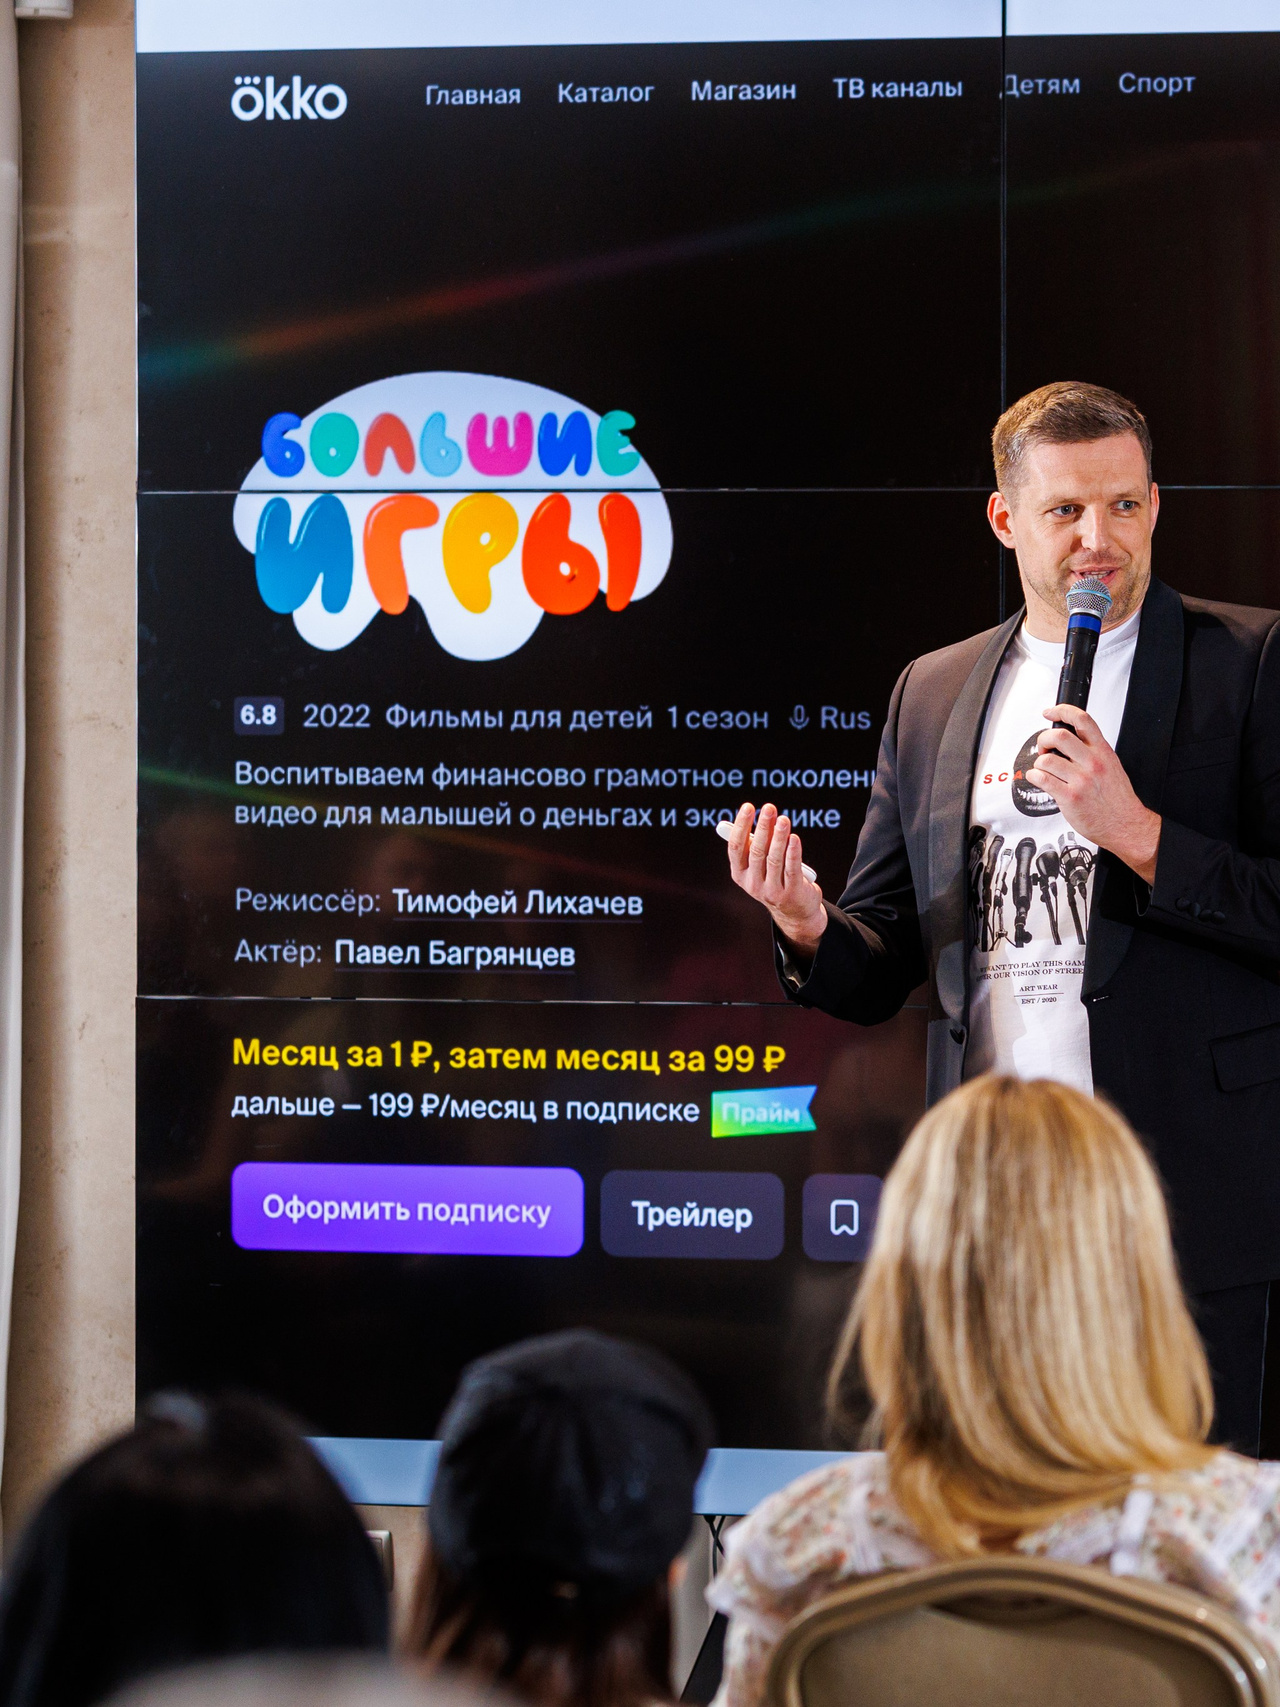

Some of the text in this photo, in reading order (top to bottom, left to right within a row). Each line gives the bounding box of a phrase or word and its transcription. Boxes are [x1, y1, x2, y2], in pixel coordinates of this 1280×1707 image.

[425, 85, 522, 105] Главная
[557, 82, 654, 104] Каталог
[691, 80, 797, 102] Магазин
[833, 78, 963, 99] ТВ каналы
[1000, 74, 1080, 98] Детям
[1118, 72, 1196, 97] Спорт
[240, 704, 277, 725] 6.8
[303, 703, 872, 731] 2022 Фильмы для детей 1 сезон Rus
[235, 761, 424, 786] Воспитываем
[431, 762, 586, 791] финансово
[593, 767, 744, 791] грамотное
[234, 805, 317, 828] видео
[323, 806, 372, 828] для
[380, 801, 511, 827] малышей
[519, 806, 536, 827] о
[542, 806, 653, 829] деньгах
[660, 807, 677, 827] и
[235, 887, 643, 918] Режиссёр: Тимофей Лихачев
[234, 938, 576, 971] Актёр: Павел Багрянцев
[1021, 961, 1041, 969] PLAY
[1012, 969, 1041, 977] VISION
[1042, 996, 1057, 1004] 2020
[232, 1038, 339, 1071] Месяц
[347, 1045, 383, 1068] за
[449, 1047, 547, 1069] затем
[556, 1049, 660, 1076] месяц
[669, 1050, 705, 1072] за
[714, 1045, 755, 1072] 99
[231, 1095, 335, 1118] дальше
[369, 1092, 413, 1117] 199
[543, 1101, 558, 1119] в
[566, 1101, 700, 1124] подписке
[721, 1102, 800, 1126] Прайм
[262, 1194, 551, 1228] Оформить подписку
[631, 1200, 753, 1233] Трейлер
